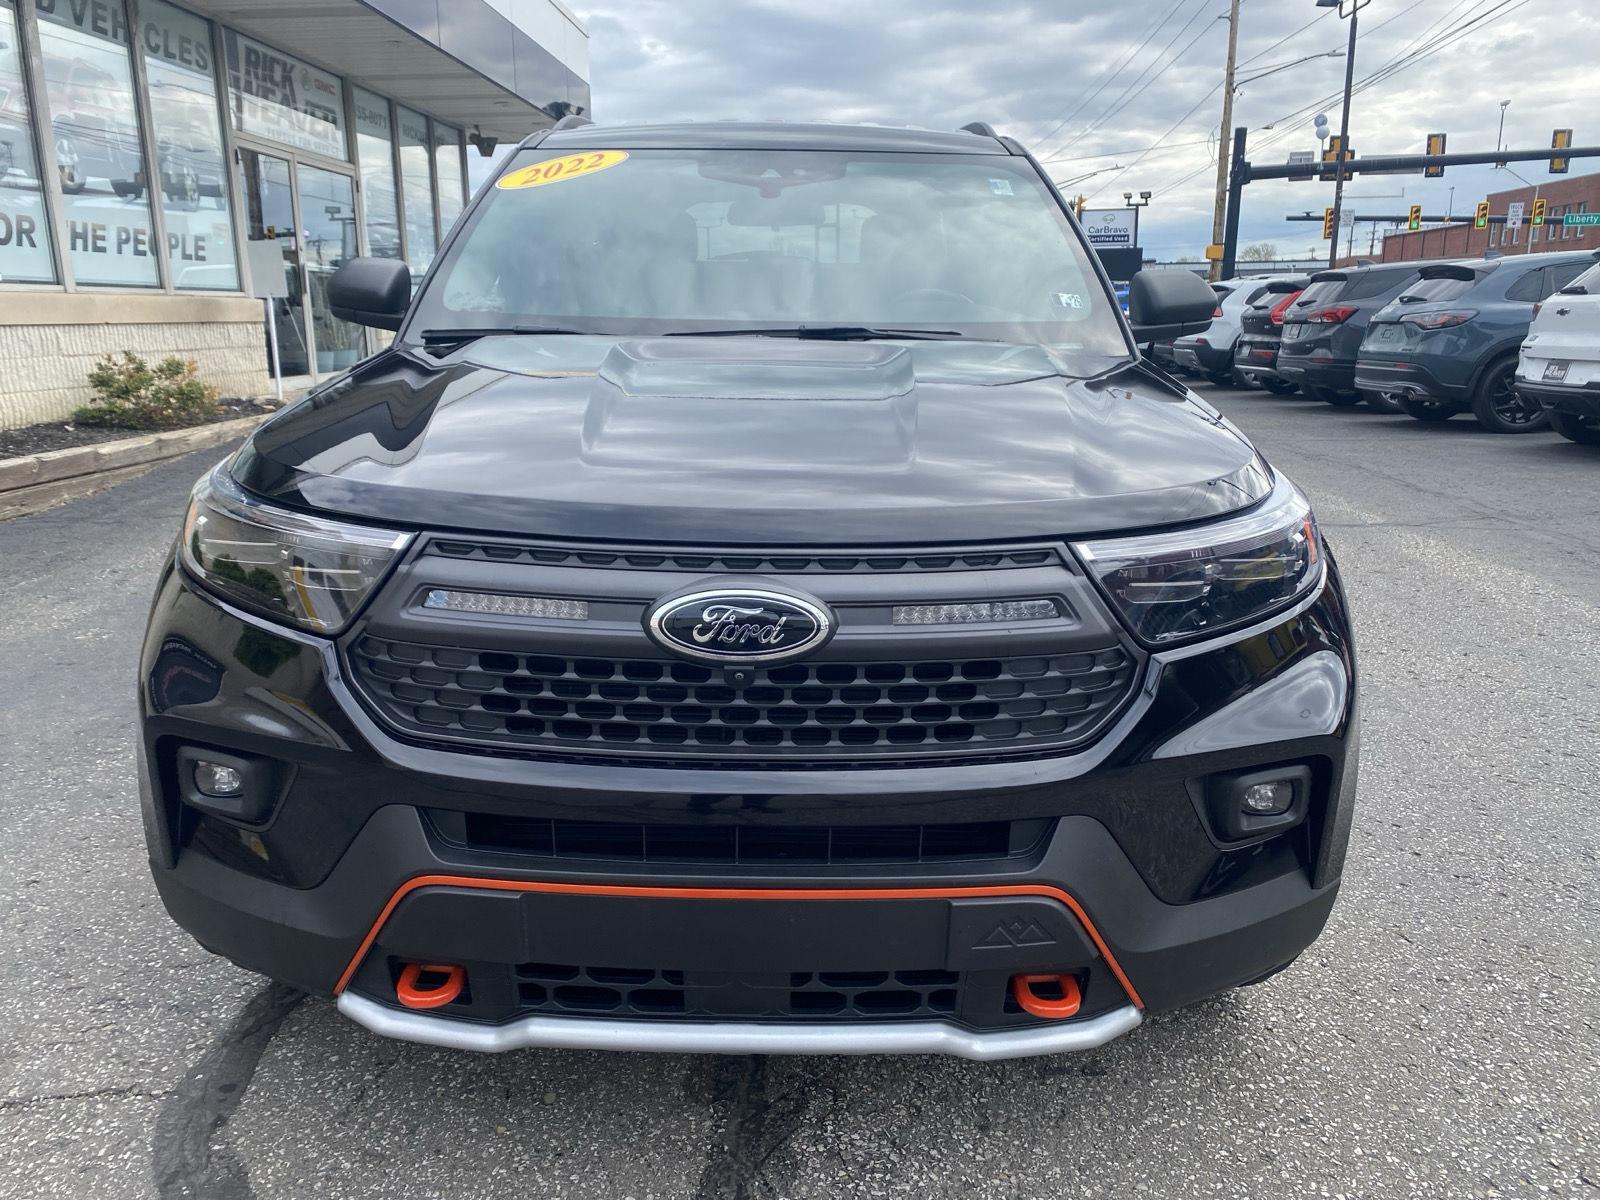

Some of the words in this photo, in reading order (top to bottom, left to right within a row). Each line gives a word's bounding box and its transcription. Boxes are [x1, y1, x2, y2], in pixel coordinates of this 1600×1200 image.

[70, 0, 208, 71] VEHCLES
[244, 45, 295, 91] RICK
[521, 153, 605, 185] 2022
[1088, 226, 1128, 234] CarBravo
[1568, 214, 1599, 225] Liberty
[66, 219, 107, 253] HE
[116, 226, 206, 262] PEPLE
[692, 604, 788, 645] Ford
